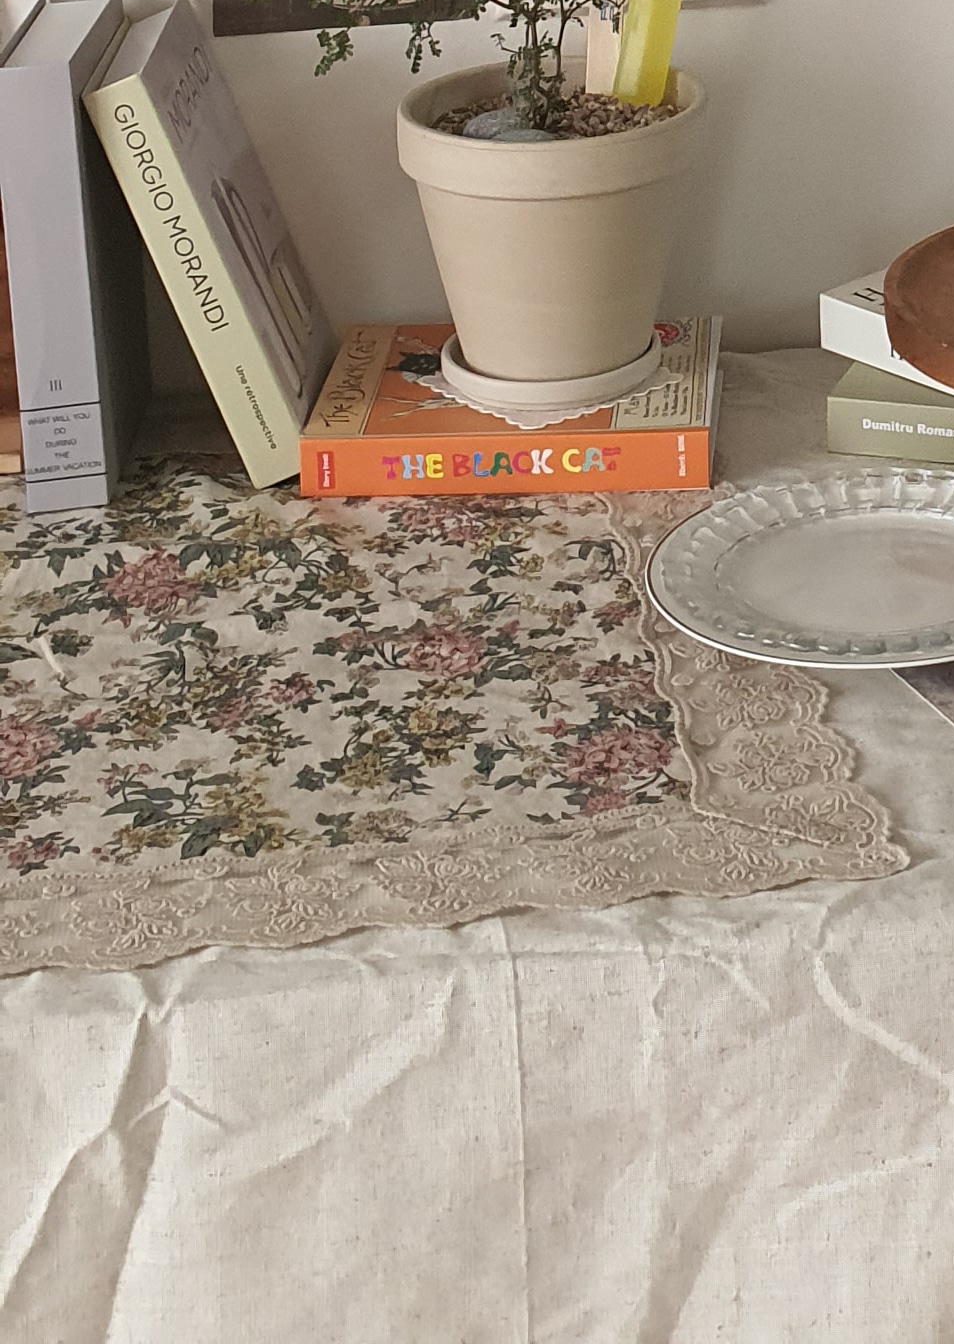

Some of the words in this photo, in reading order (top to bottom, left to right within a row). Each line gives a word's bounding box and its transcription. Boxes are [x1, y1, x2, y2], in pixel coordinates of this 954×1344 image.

[114, 103, 174, 211] GIORGIO
[162, 215, 230, 332] MORANDI
[27, 415, 51, 426] WHAT
[52, 415, 71, 423] WILL
[73, 412, 92, 421] YOU
[862, 417, 914, 434] Dumitru
[45, 438, 78, 449] DURING
[381, 452, 445, 481] THE
[452, 447, 555, 479] BLACK
[561, 446, 622, 475] CAT
